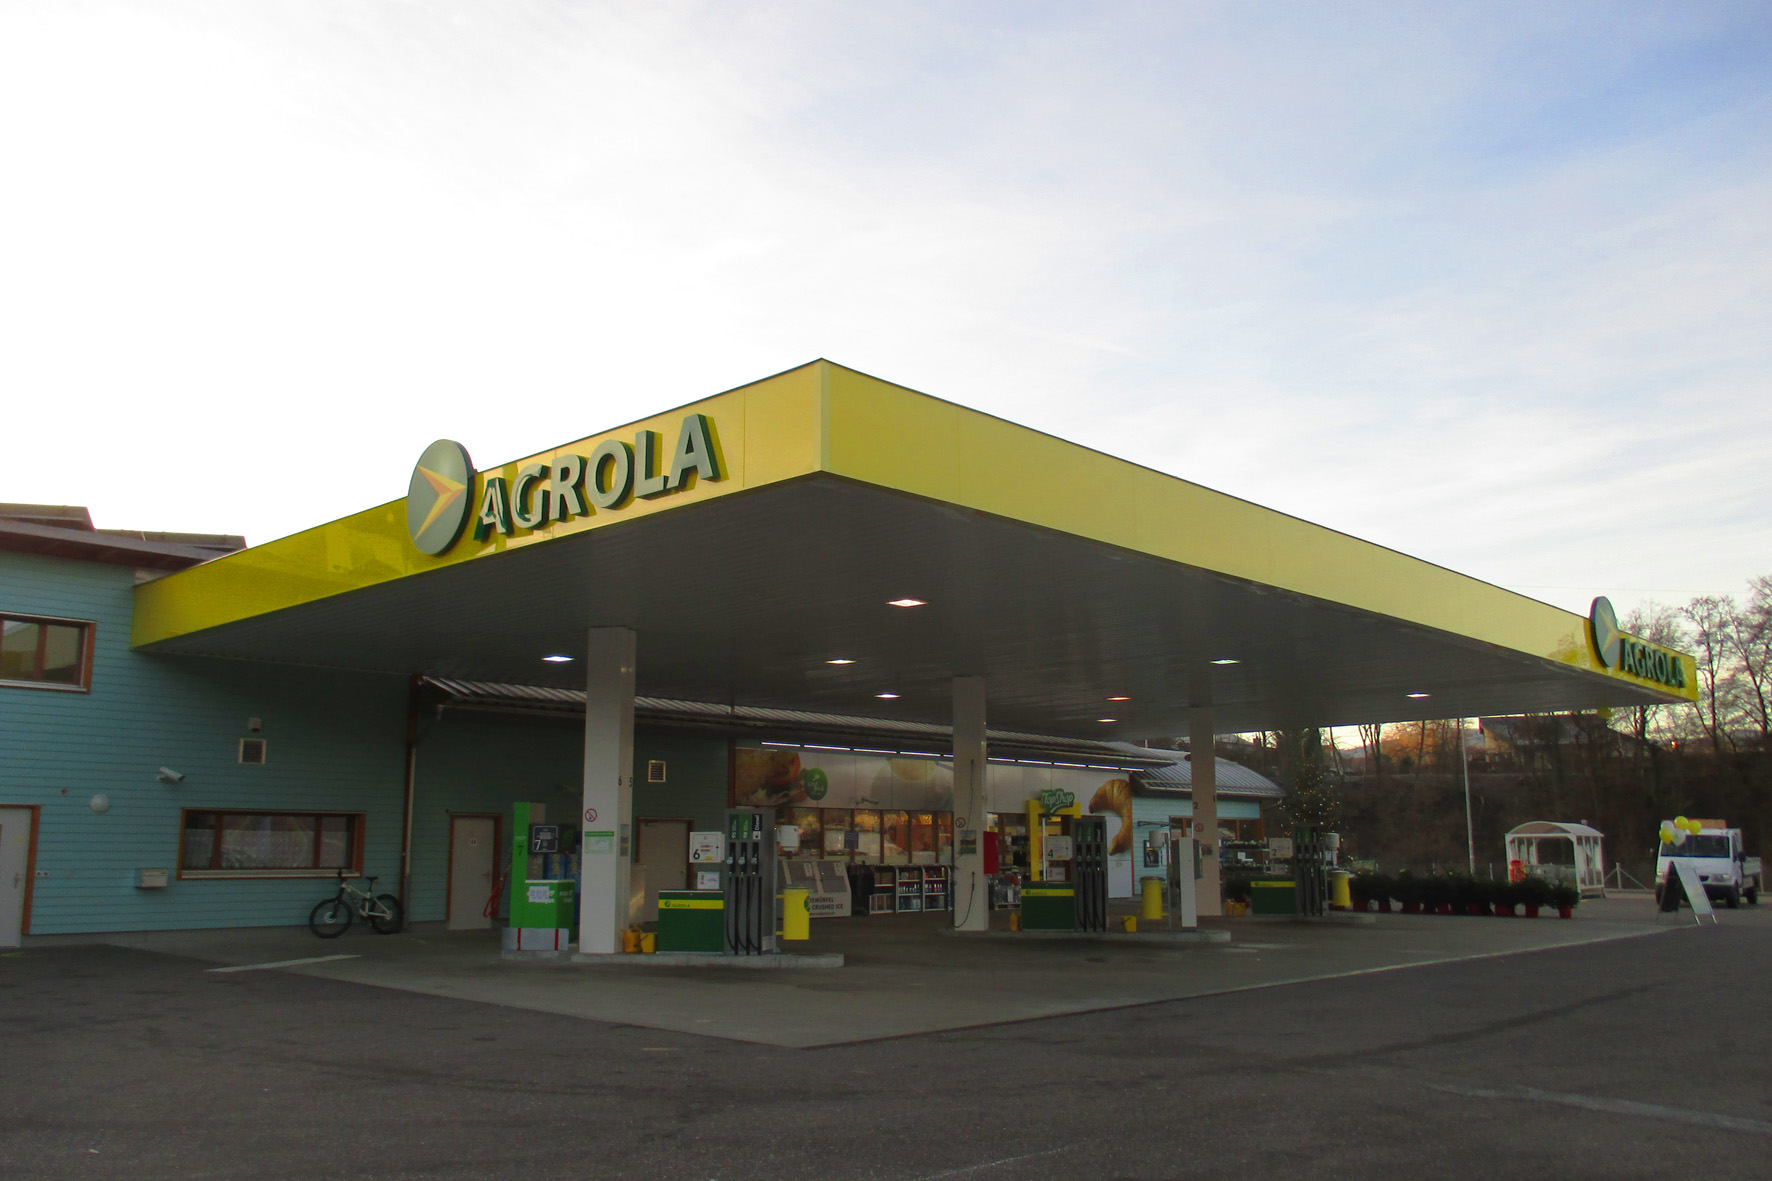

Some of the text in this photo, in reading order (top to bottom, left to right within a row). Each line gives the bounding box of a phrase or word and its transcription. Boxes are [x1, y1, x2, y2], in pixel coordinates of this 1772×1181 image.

[474, 413, 720, 541] AGROLA
[1621, 638, 1685, 688] AGROLA
[517, 845, 524, 856] 7
[534, 840, 542, 850] 7
[693, 849, 700, 860] 6
[1048, 849, 1053, 858] 4
